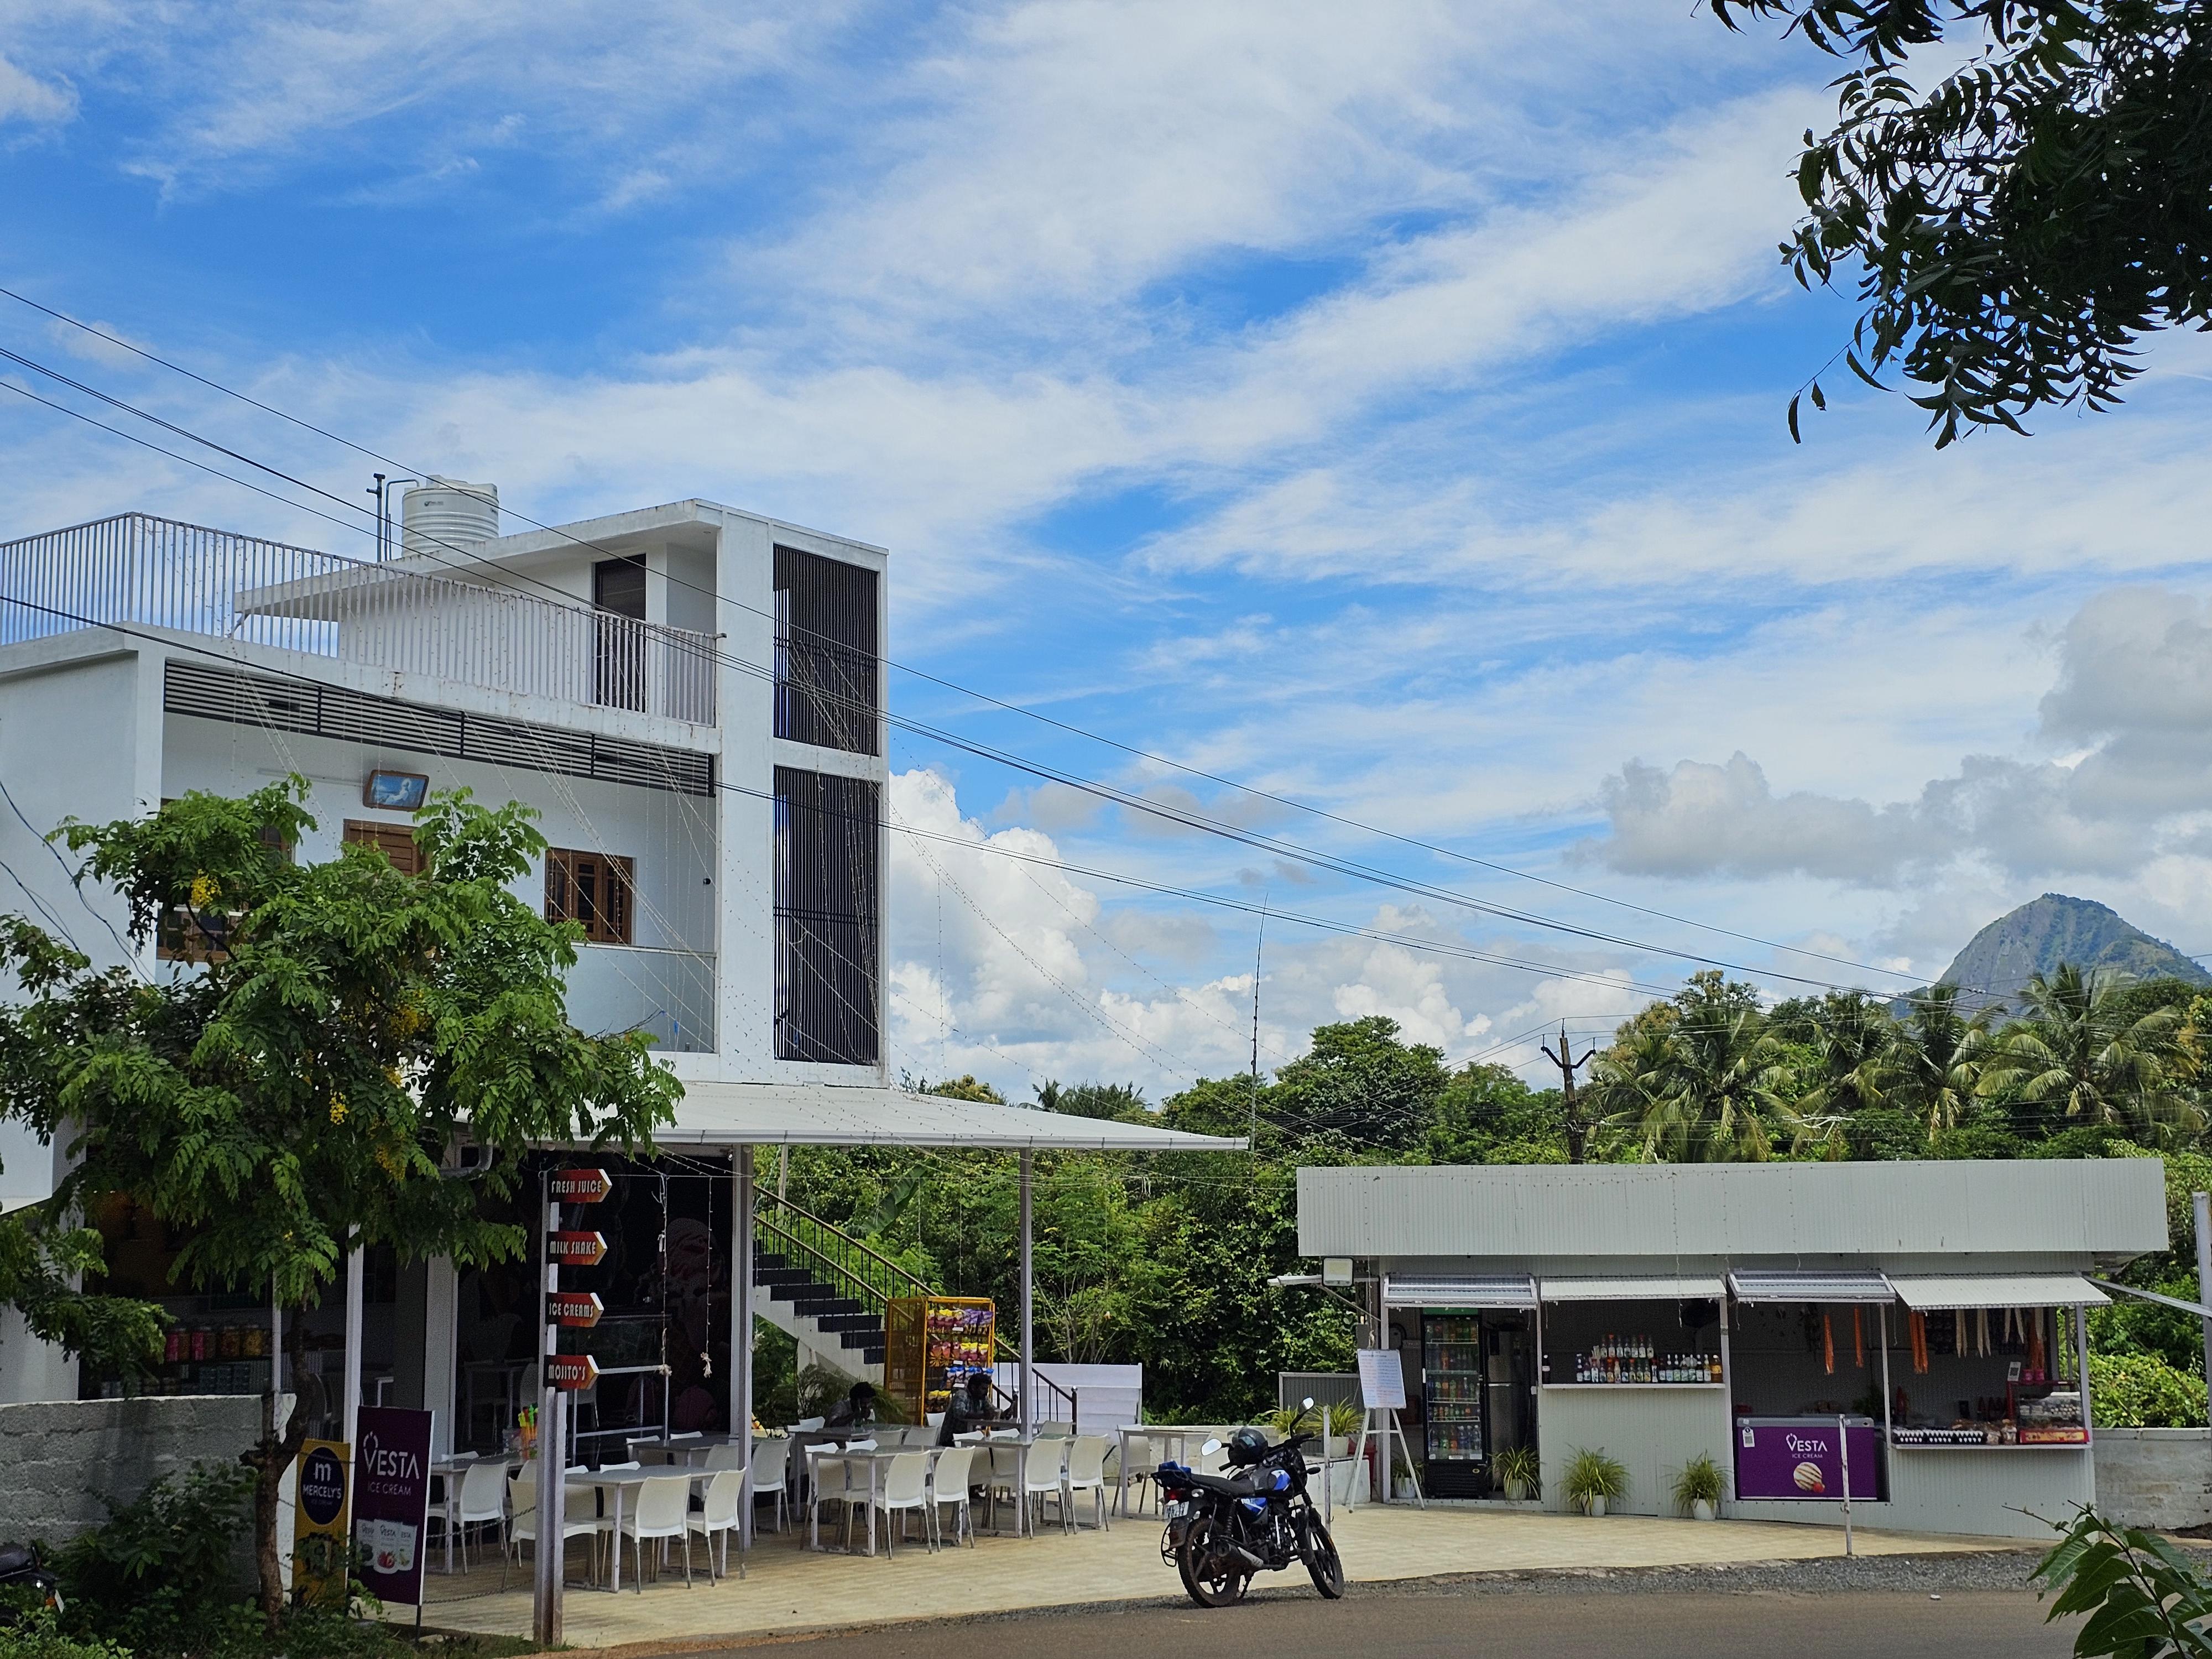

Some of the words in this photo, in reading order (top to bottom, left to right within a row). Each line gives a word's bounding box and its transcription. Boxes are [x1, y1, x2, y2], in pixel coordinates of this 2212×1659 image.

[551, 1180, 575, 1193] FRESH
[577, 1180, 602, 1193] JUICE
[550, 1240, 568, 1254] MILK
[571, 1241, 596, 1254] SHAKE
[549, 1302, 561, 1316] ICE
[564, 1303, 593, 1318] CREAMS
[548, 1364, 586, 1381] MOJITO'S
[1786, 1433, 1828, 1452] VESTA
[363, 1431, 420, 1480] VESTA
[302, 1484, 342, 1499] MERCELY'S
[367, 1481, 381, 1493] ICE
[382, 1483, 411, 1496] CREAM
